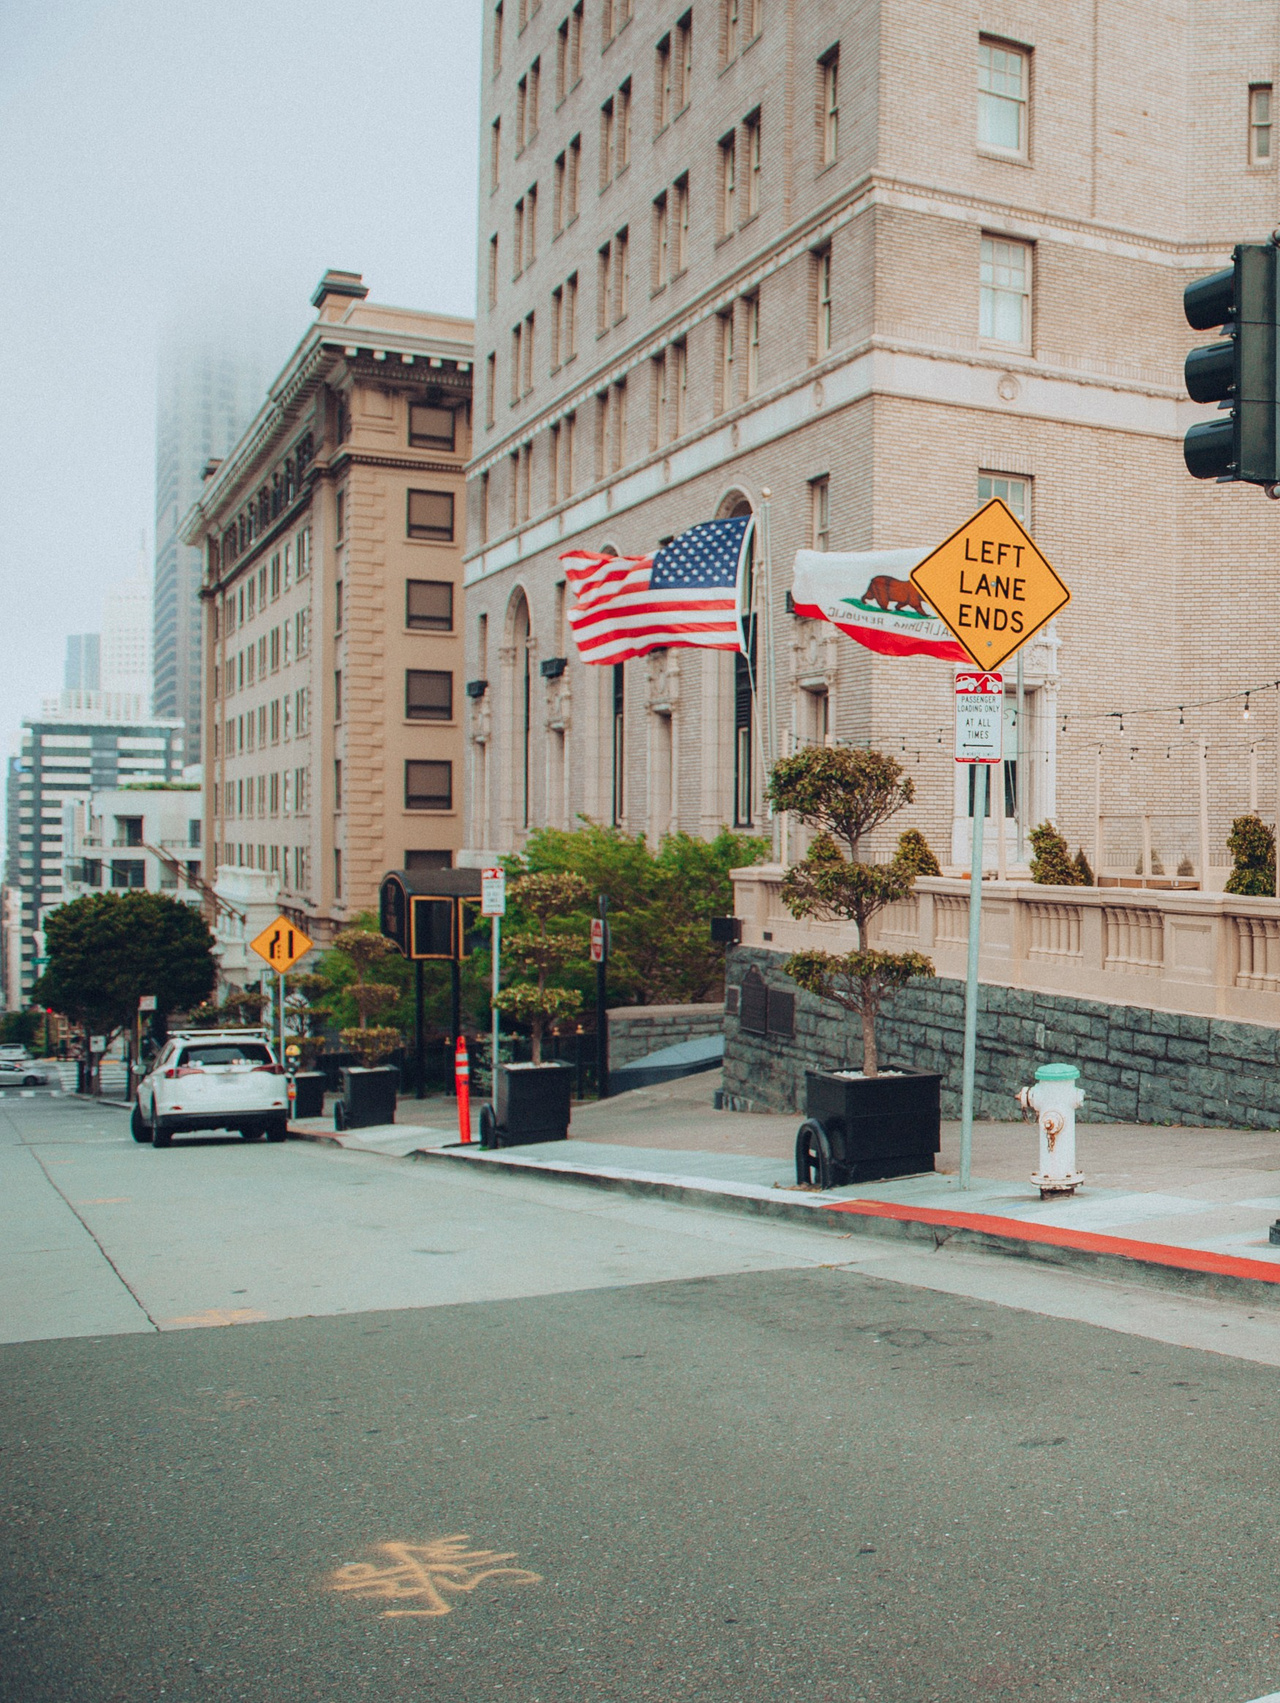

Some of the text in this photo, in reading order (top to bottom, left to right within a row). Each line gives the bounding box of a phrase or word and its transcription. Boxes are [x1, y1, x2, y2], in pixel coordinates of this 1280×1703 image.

[964, 538, 1025, 567] LEFT
[959, 570, 1026, 601] LANE
[958, 604, 1024, 633] ENDS
[961, 696, 996, 704] PASSENGER
[957, 705, 1000, 713] LOADING ONLY
[966, 718, 991, 727] AT ALL
[968, 730, 989, 739] TIMES
